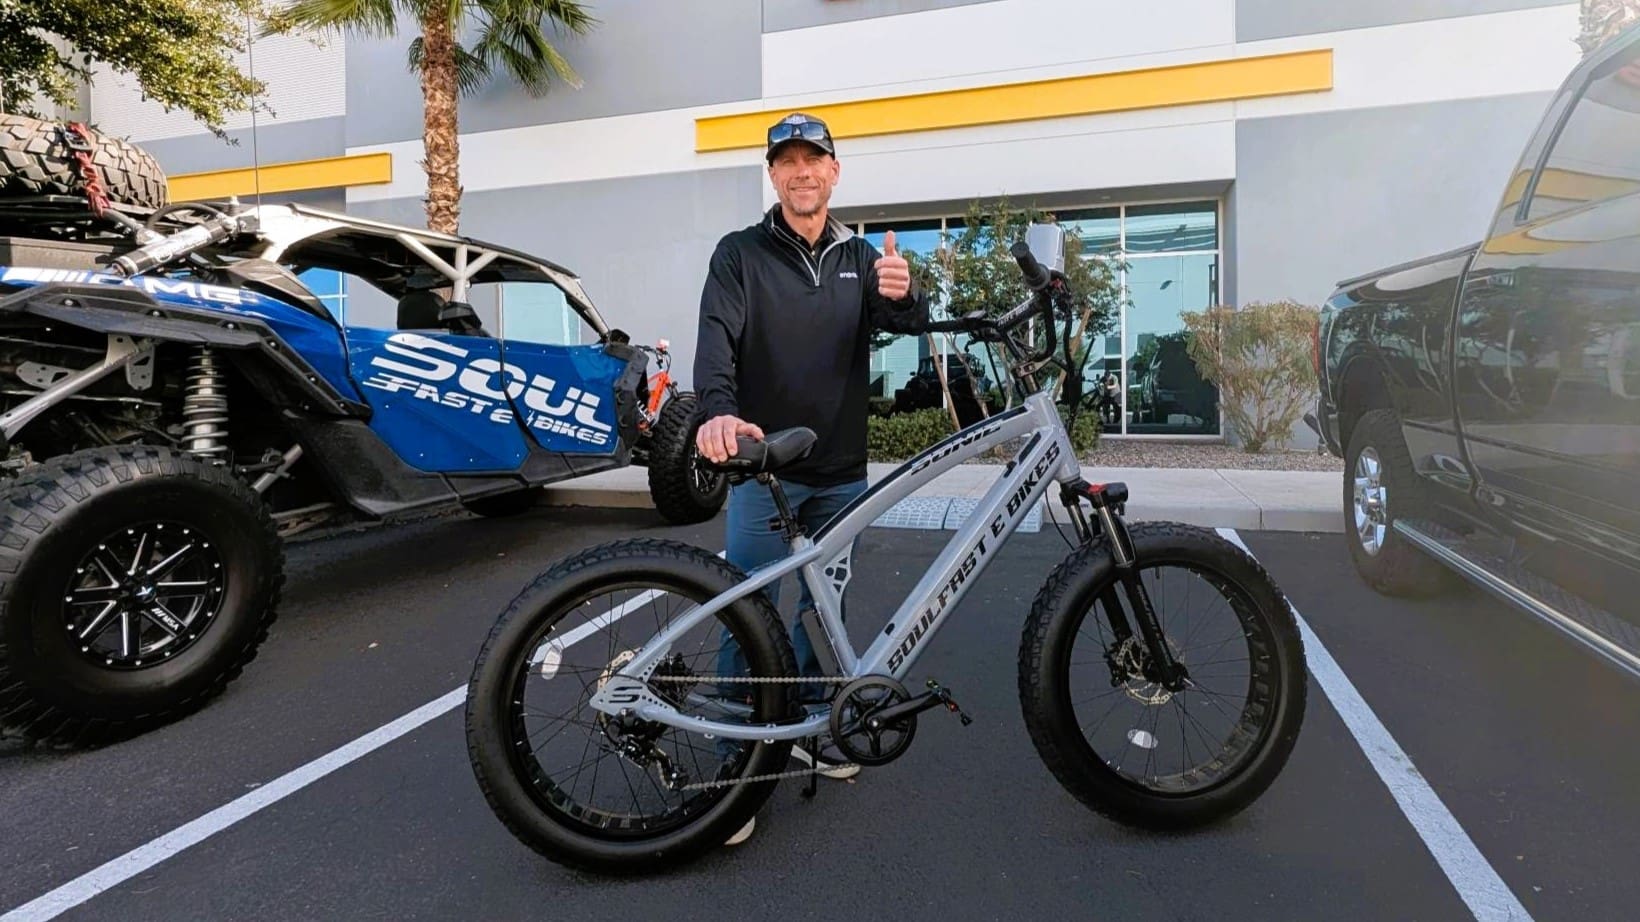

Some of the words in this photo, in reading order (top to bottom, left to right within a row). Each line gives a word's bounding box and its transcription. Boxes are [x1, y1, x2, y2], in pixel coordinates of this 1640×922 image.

[363, 373, 493, 414] FAST
[533, 415, 609, 445] BIKES
[371, 333, 612, 432] SOUL
[911, 419, 1003, 476] SONIC
[992, 514, 1006, 539] E
[1007, 441, 1061, 518] BIKES
